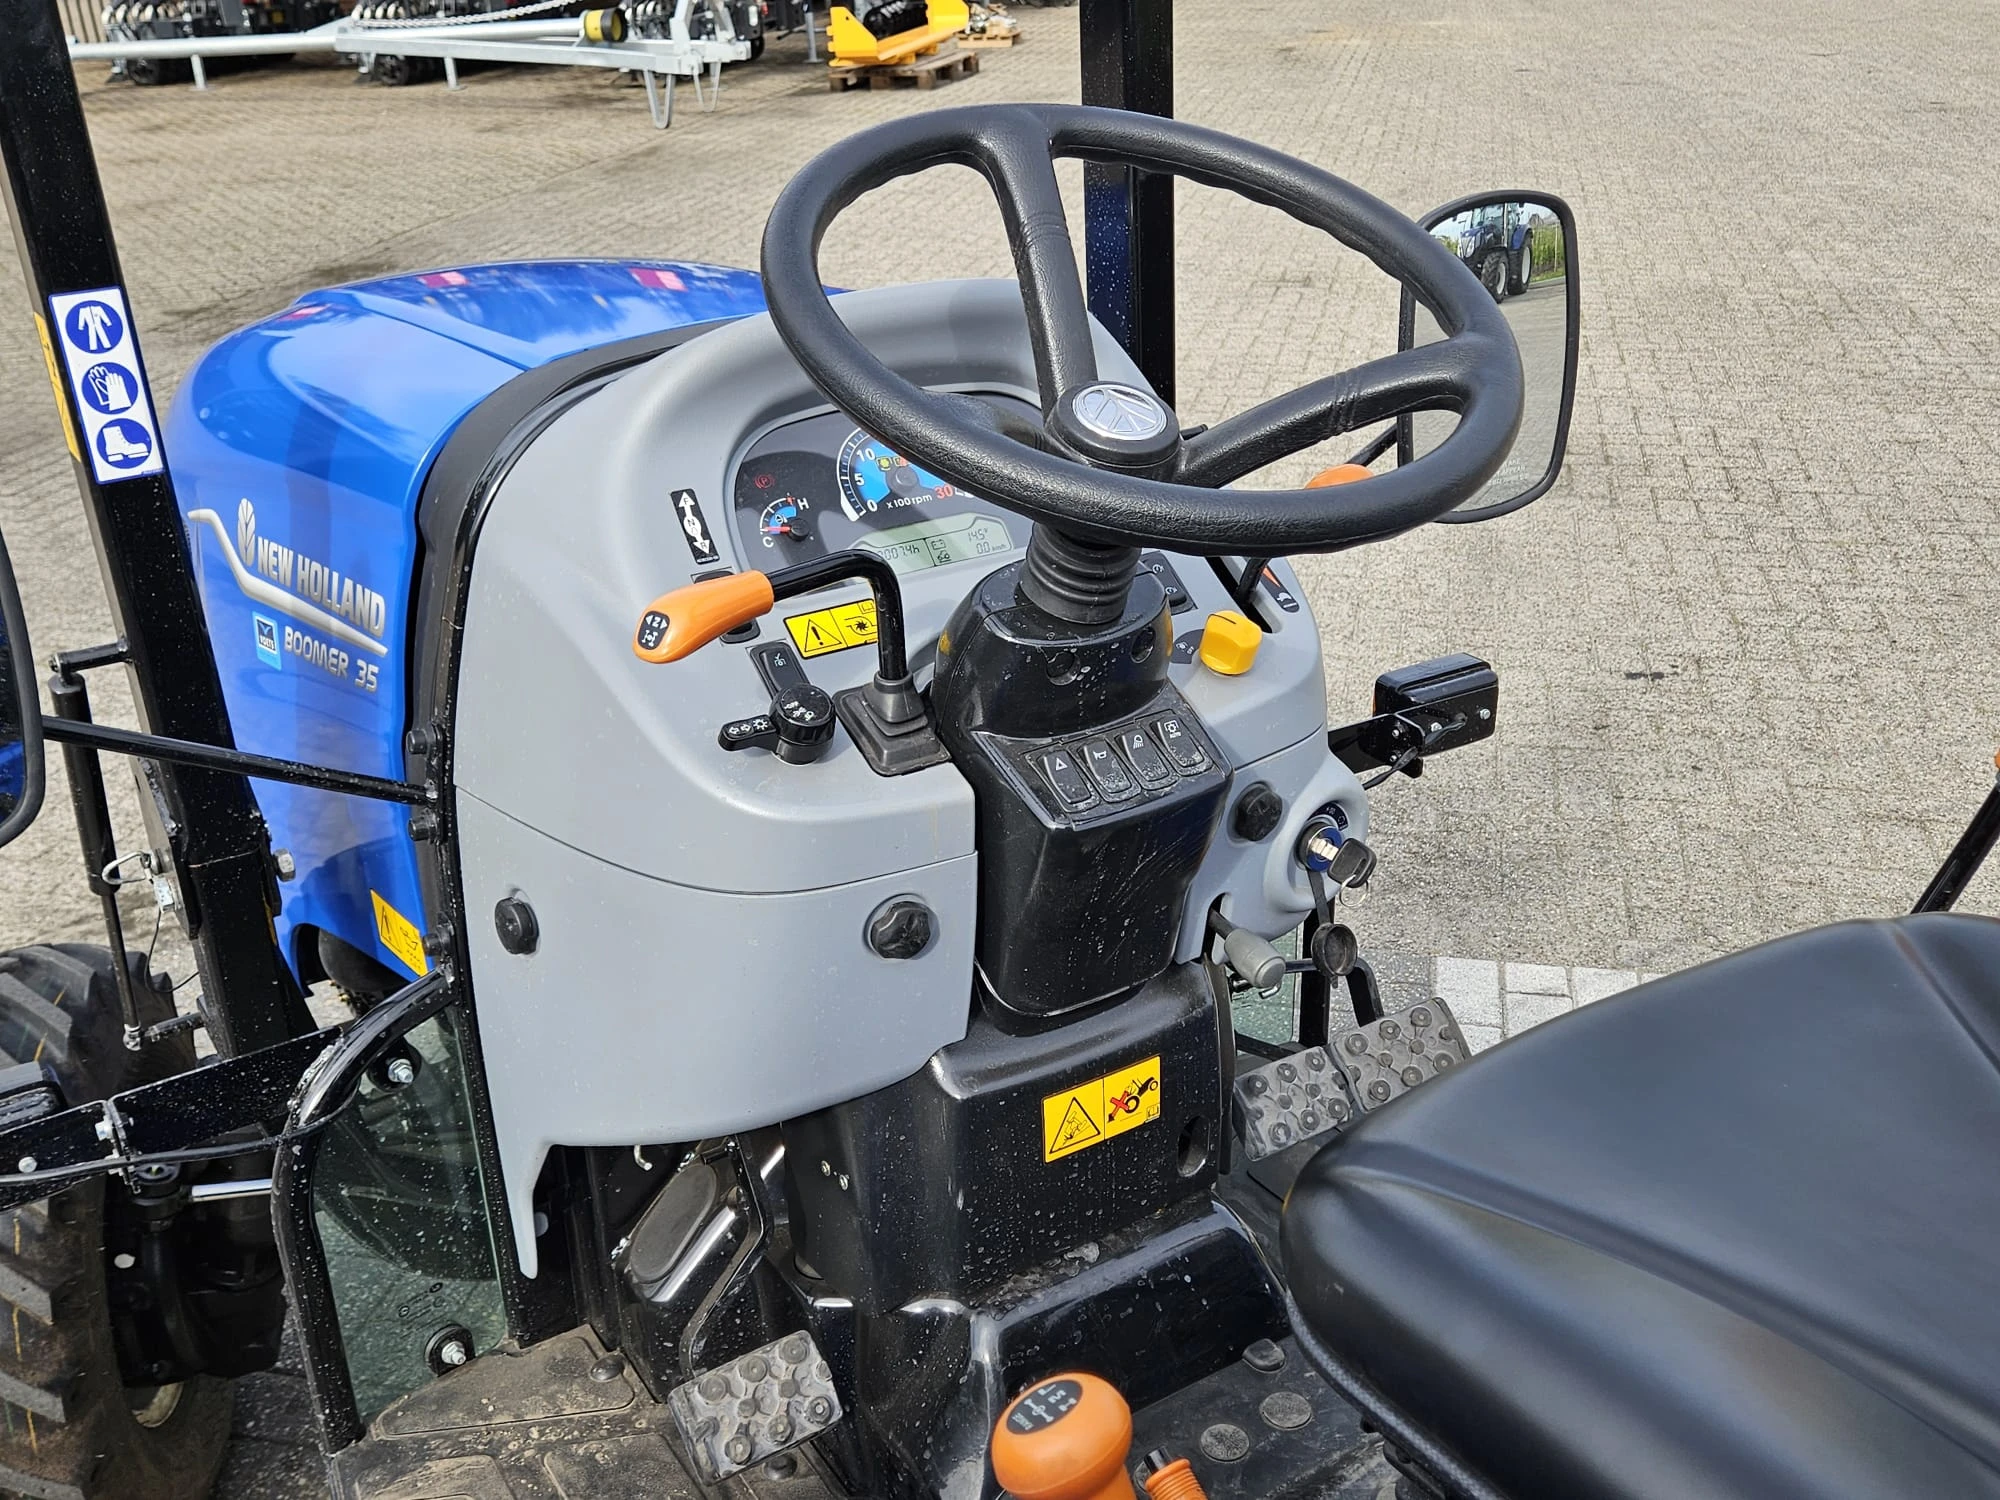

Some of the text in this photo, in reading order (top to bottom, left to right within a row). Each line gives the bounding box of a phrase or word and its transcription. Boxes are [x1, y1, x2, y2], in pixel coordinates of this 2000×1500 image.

[856, 447, 876, 462] 10
[854, 472, 865, 486] 5
[934, 483, 953, 500] 30
[797, 497, 810, 510] H
[866, 499, 878, 512] 0
[762, 536, 774, 548] C
[257, 536, 386, 639] NEW HOLLAND
[283, 626, 379, 693] BOOMER 35
